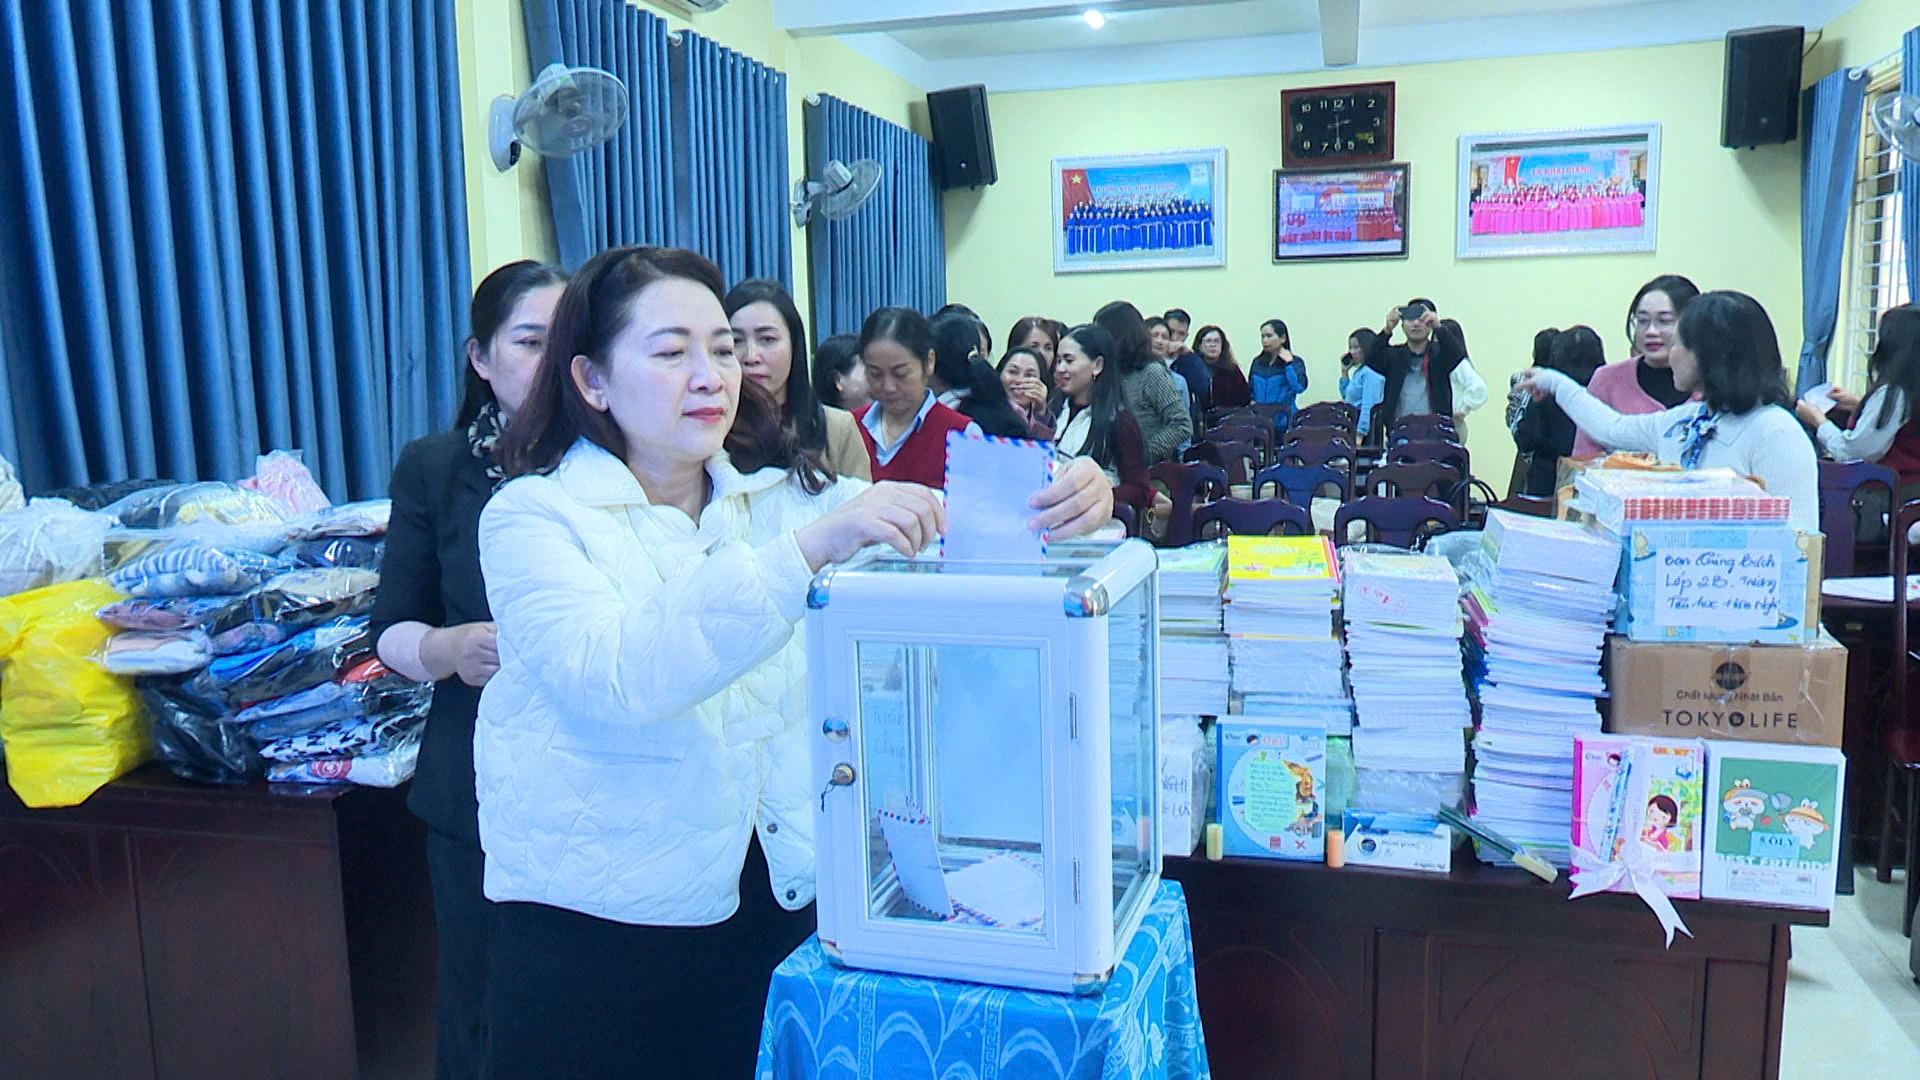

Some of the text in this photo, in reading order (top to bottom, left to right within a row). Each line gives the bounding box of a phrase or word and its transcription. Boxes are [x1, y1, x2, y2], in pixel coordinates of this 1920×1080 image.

[1301, 103, 1312, 113] 10
[1320, 100, 1328, 110] 11
[1333, 99, 1344, 108] 12
[1367, 99, 1376, 108] 2
[1321, 142, 1329, 153] 7
[1663, 709, 1798, 728] TOKYOLIFE
